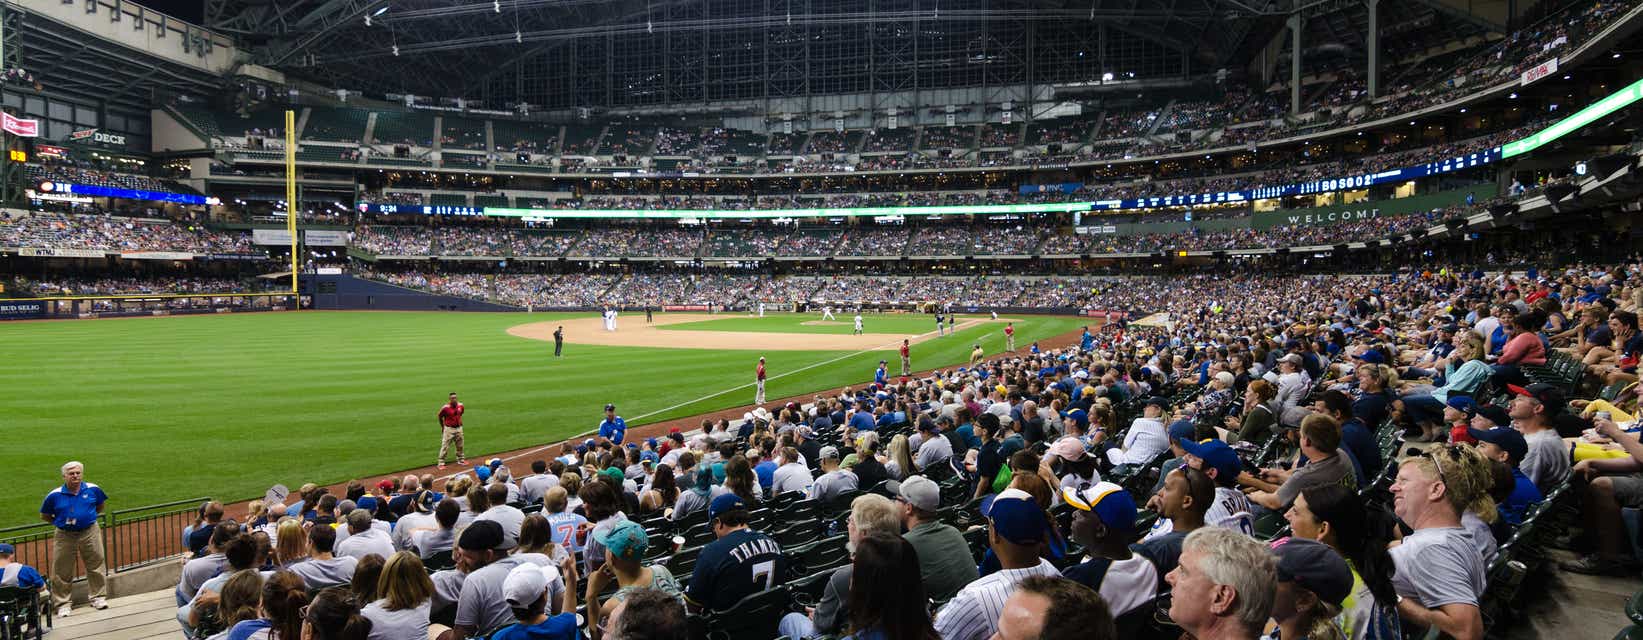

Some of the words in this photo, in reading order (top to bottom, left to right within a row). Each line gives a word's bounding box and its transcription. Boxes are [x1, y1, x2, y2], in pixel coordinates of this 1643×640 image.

[94, 132, 126, 145] DECK
[380, 205, 397, 213] 9:24
[557, 523, 574, 548] 7
[752, 560, 775, 592] 7
